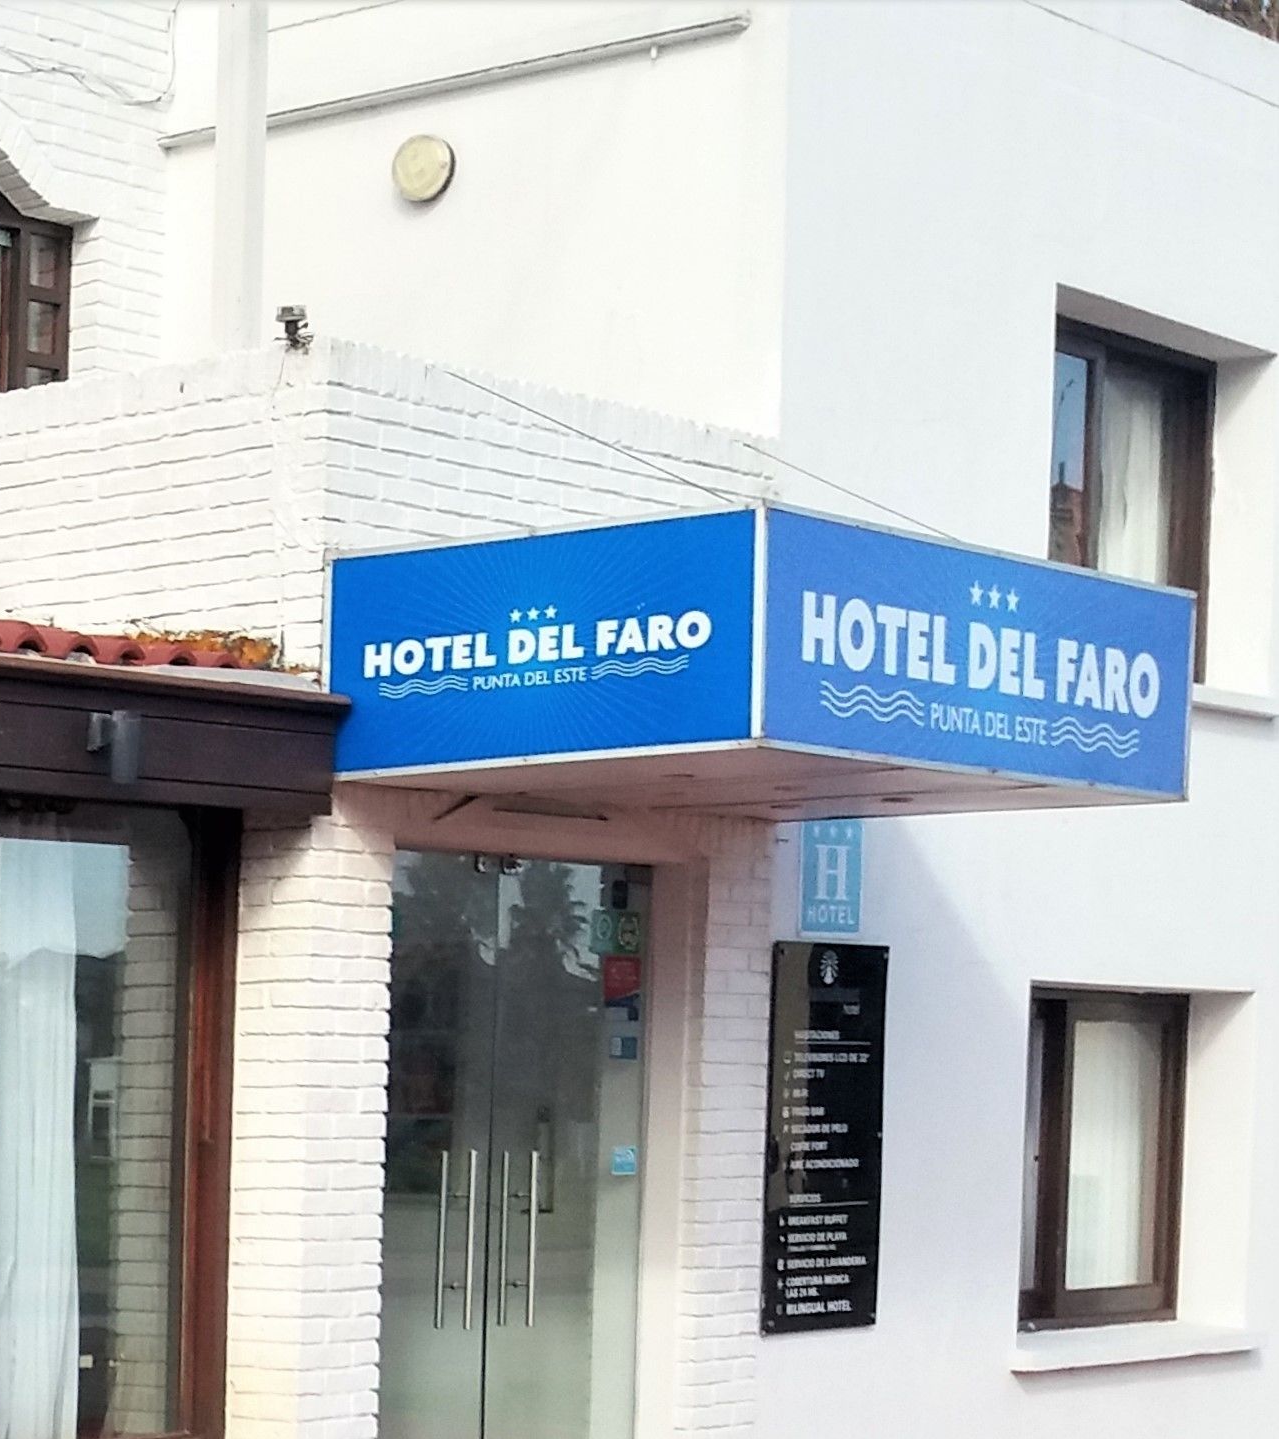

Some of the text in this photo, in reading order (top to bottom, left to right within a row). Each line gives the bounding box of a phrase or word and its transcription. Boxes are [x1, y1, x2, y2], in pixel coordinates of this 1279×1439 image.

[363, 610, 712, 678] HOTEL DEL FARO
[801, 590, 1160, 719] HOTEL DEL FARO
[472, 667, 587, 691] PUNTA DEL ESTE
[930, 703, 1047, 745] PUNTA DEL ESTE
[815, 843, 850, 901] H
[807, 903, 856, 925] HOTEL
[826, 1299, 852, 1312] HOTEL
